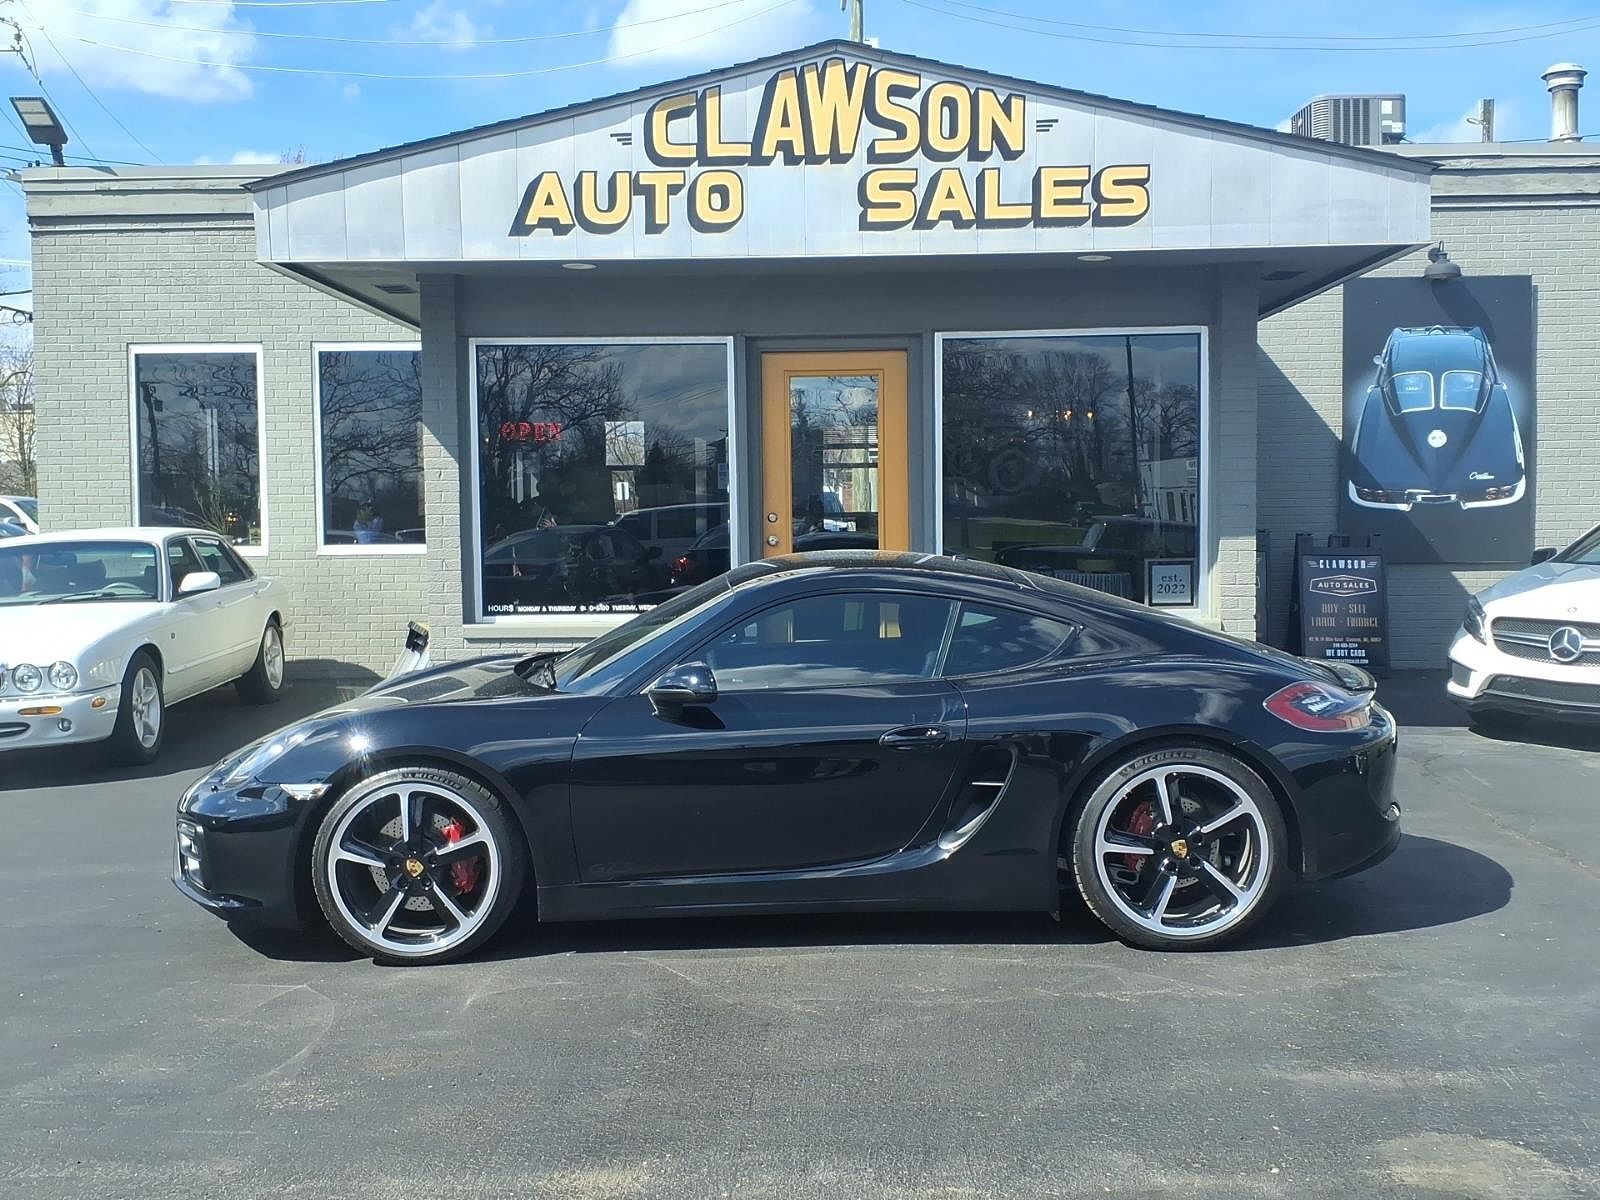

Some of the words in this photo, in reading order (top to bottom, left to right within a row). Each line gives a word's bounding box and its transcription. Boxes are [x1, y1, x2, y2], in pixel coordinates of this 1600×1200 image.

[643, 57, 1027, 166] CLAWSON
[509, 169, 745, 236] AUTO
[857, 163, 1152, 232] SALES
[500, 422, 562, 441] OPEN
[1319, 559, 1367, 569] CLAWSON
[1161, 573, 1183, 583] est.
[1156, 583, 1186, 594] 2022
[487, 604, 515, 613] HOURS
